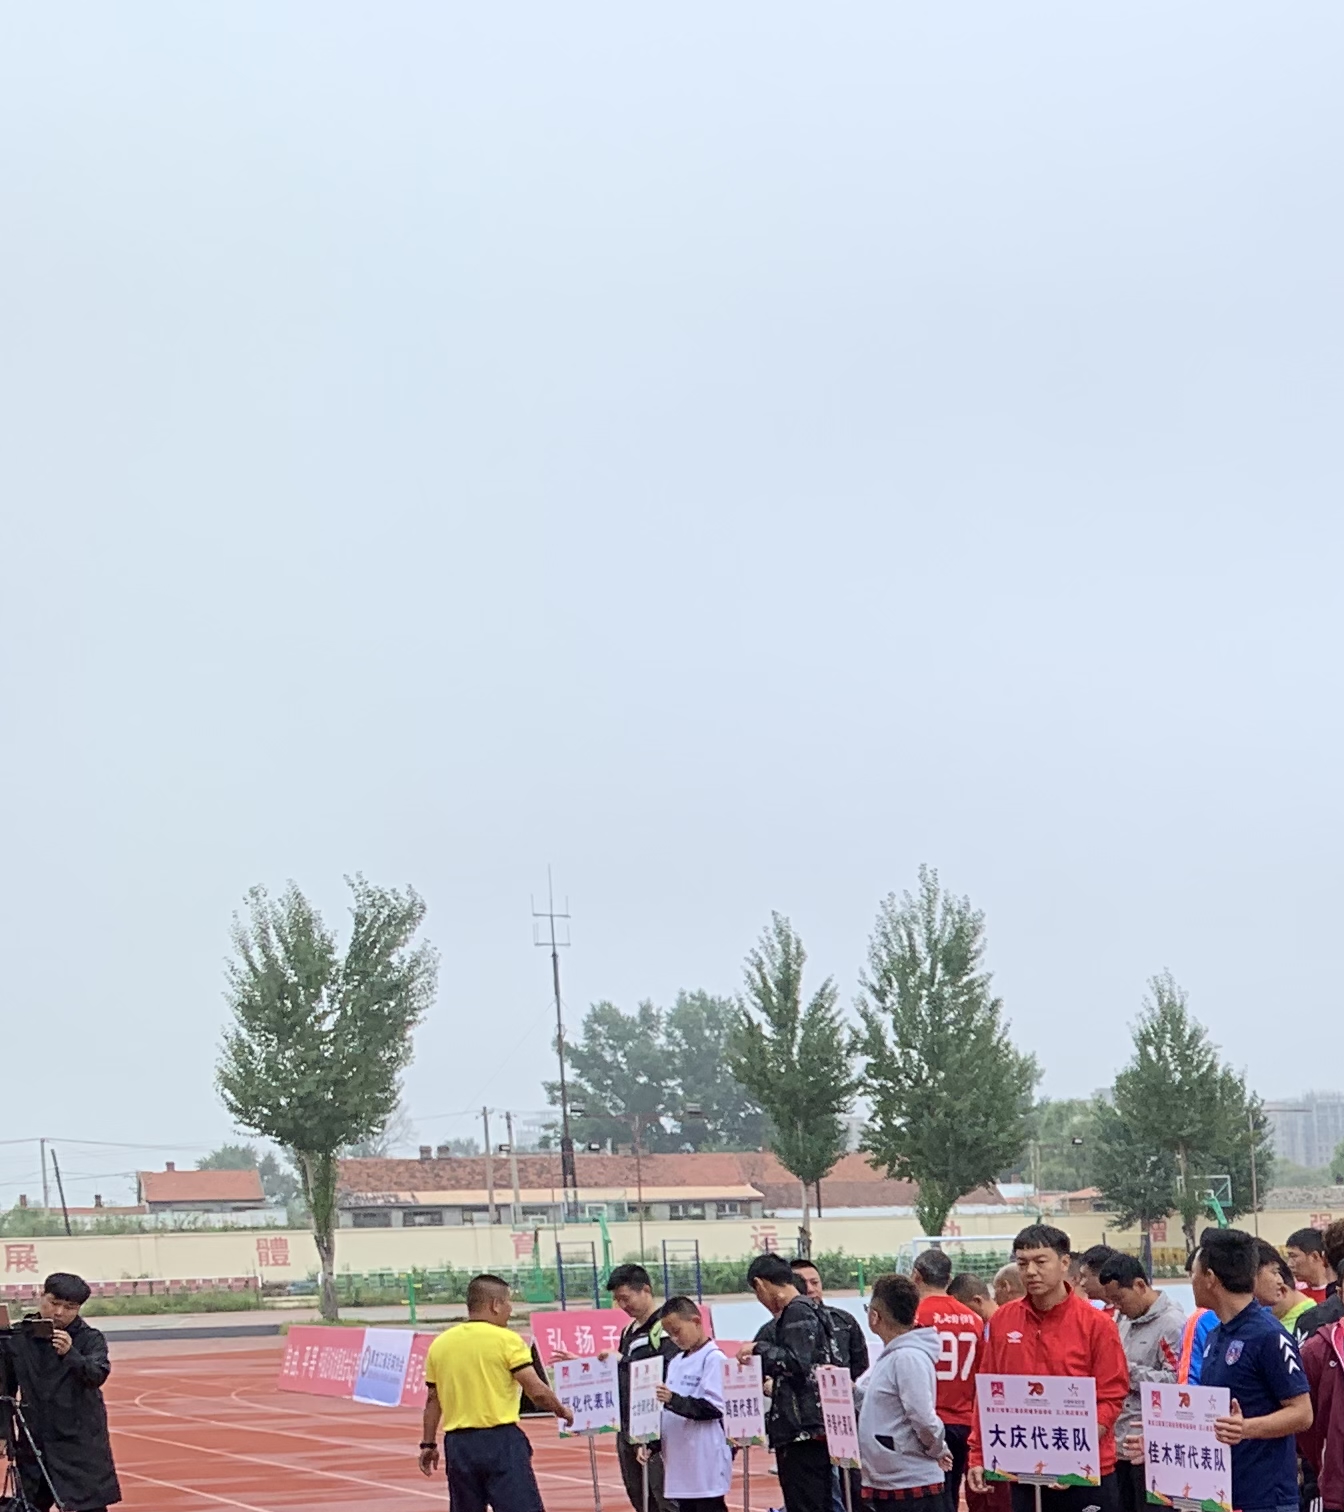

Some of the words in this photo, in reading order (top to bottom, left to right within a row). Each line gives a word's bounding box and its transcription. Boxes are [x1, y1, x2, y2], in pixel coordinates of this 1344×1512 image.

[4, 1243, 39, 1273] 展
[256, 1237, 291, 1267] 體
[937, 1332, 978, 1381] 97
[989, 1424, 1091, 1452] 大庆代表队
[1148, 1441, 1226, 1472] 佳木斯代表队
